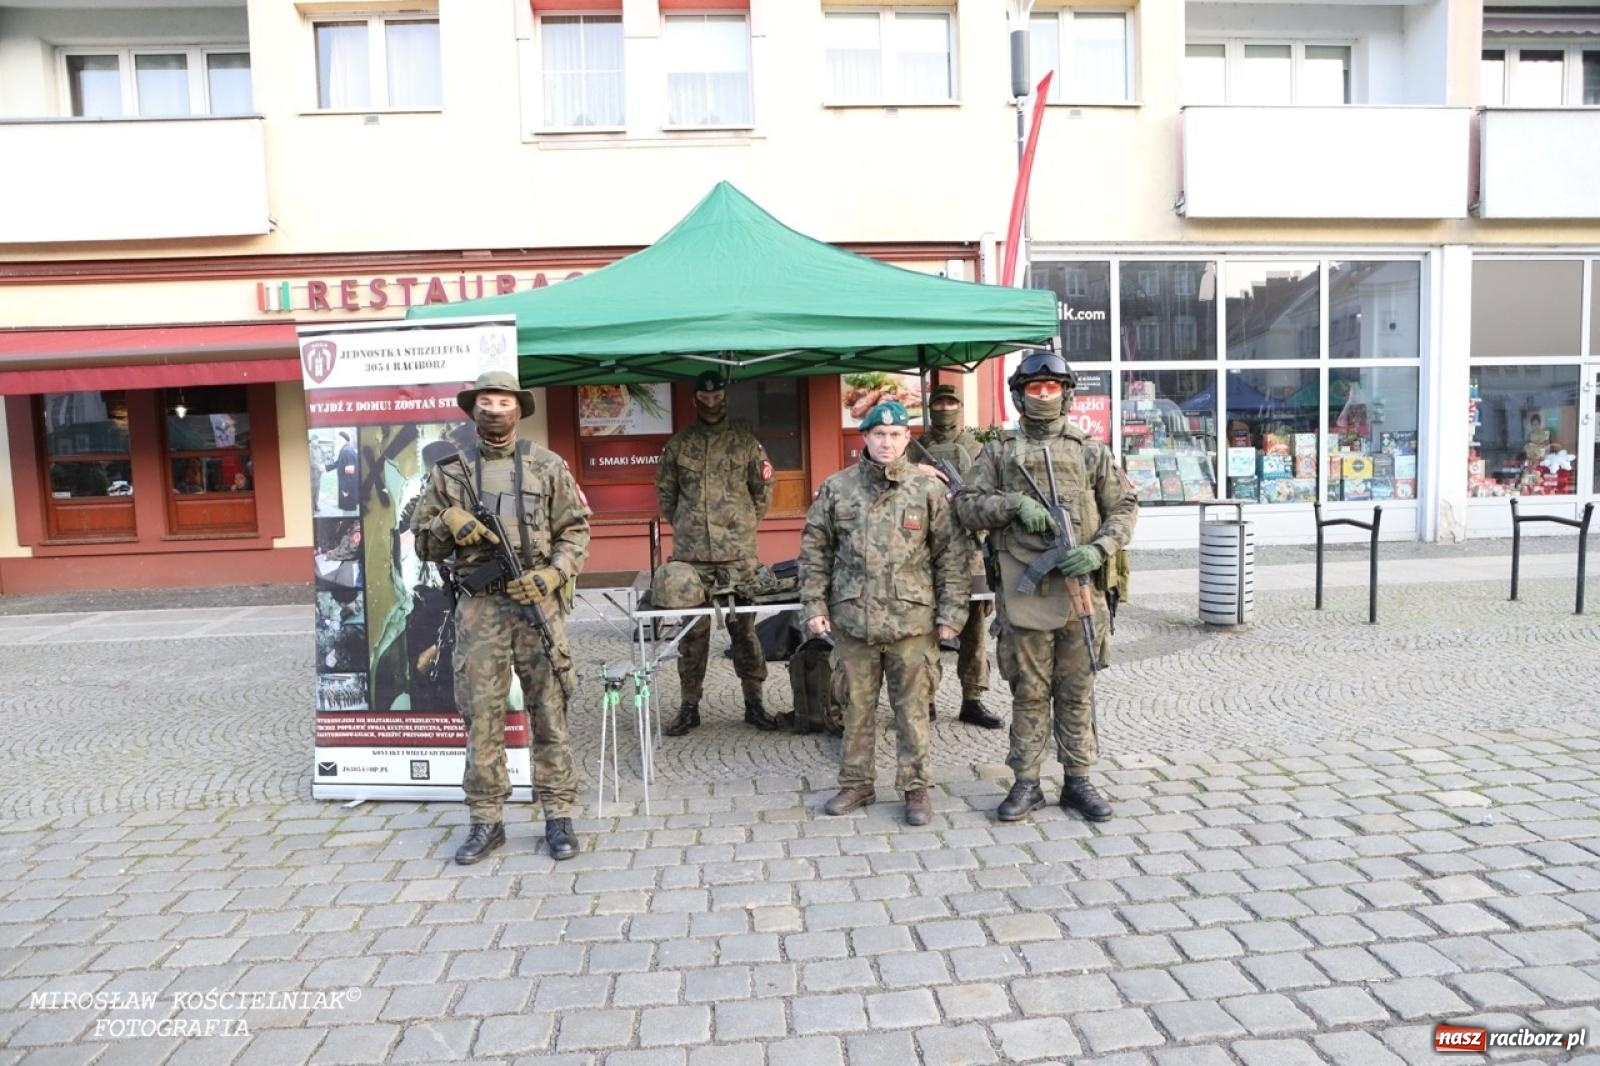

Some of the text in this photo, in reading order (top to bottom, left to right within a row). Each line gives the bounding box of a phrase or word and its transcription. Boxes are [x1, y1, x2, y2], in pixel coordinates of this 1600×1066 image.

[307, 271, 584, 311] RESTAURA
[1057, 301, 1106, 320] ik.com
[340, 345, 471, 360] JEDNOSTKA STRZELECKA
[346, 402, 353, 411] Z
[356, 400, 391, 411] DOMU!
[394, 396, 436, 411] ZOSTAŃ
[599, 456, 628, 466] SMAKI
